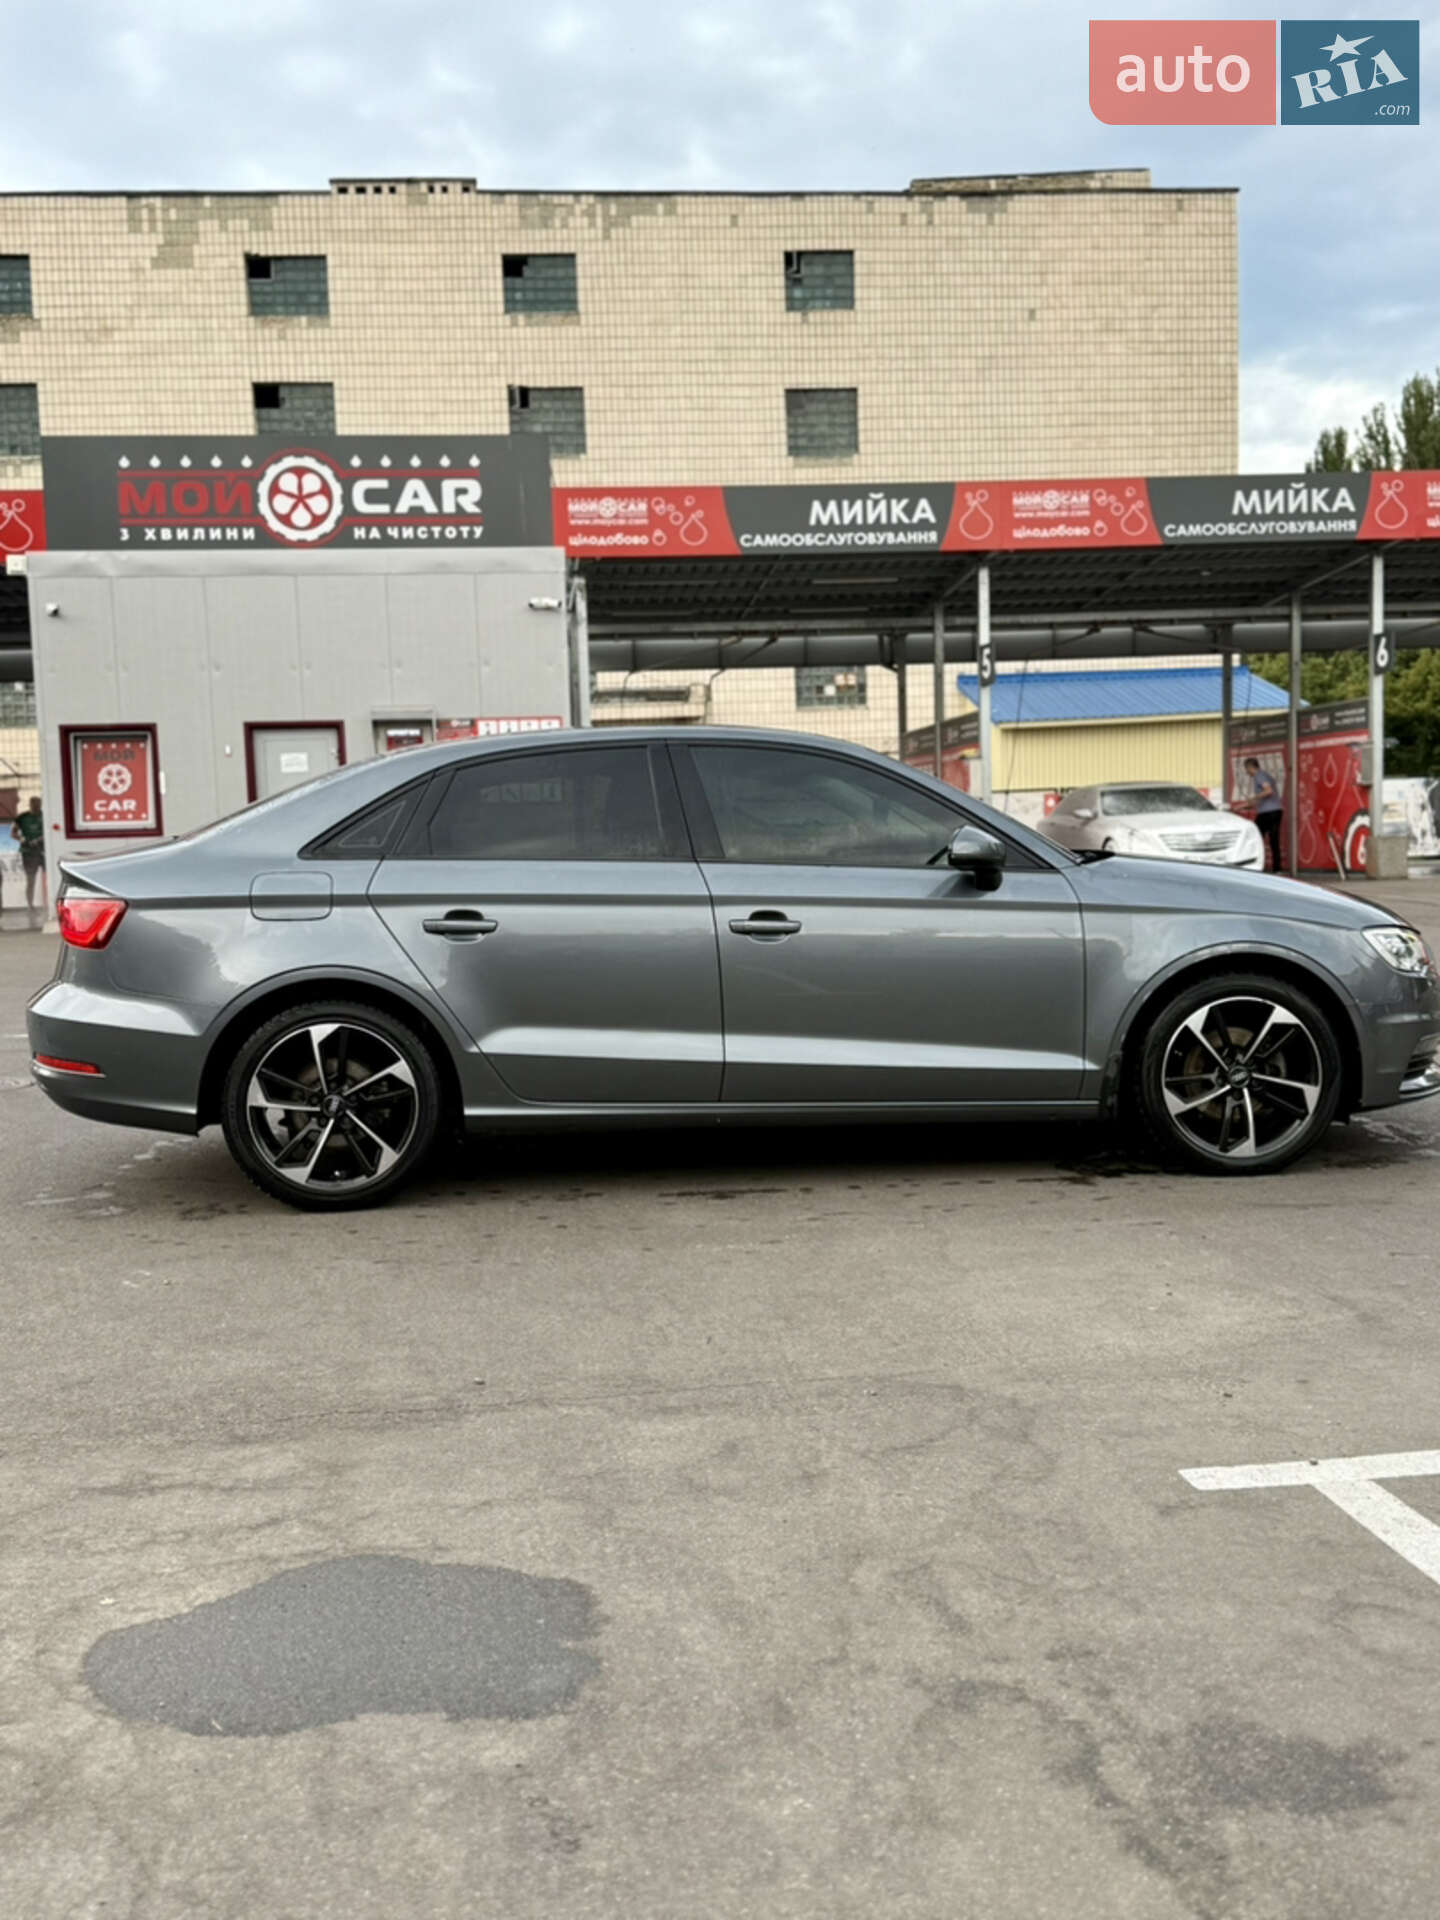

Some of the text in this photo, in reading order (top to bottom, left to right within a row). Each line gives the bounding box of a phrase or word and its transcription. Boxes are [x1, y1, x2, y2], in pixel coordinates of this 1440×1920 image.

[118, 472, 483, 515] МОЙ CAR
[1231, 482, 1356, 516] МИЙКА
[808, 491, 937, 527] МИЙКА
[144, 527, 256, 541] ХВИЛИНИ
[353, 526, 382, 540] НА
[386, 525, 484, 540] ЧИСТОТУ
[568, 532, 649, 547] цілодобово
[738, 530, 939, 548] САМООБСЛУГОВУВАННЯ
[1163, 519, 1357, 538] САМООБСЛУГОВУВАННЯ
[982, 647, 991, 680] 5
[1376, 636, 1389, 668] 6
[94, 799, 137, 812] CAR
